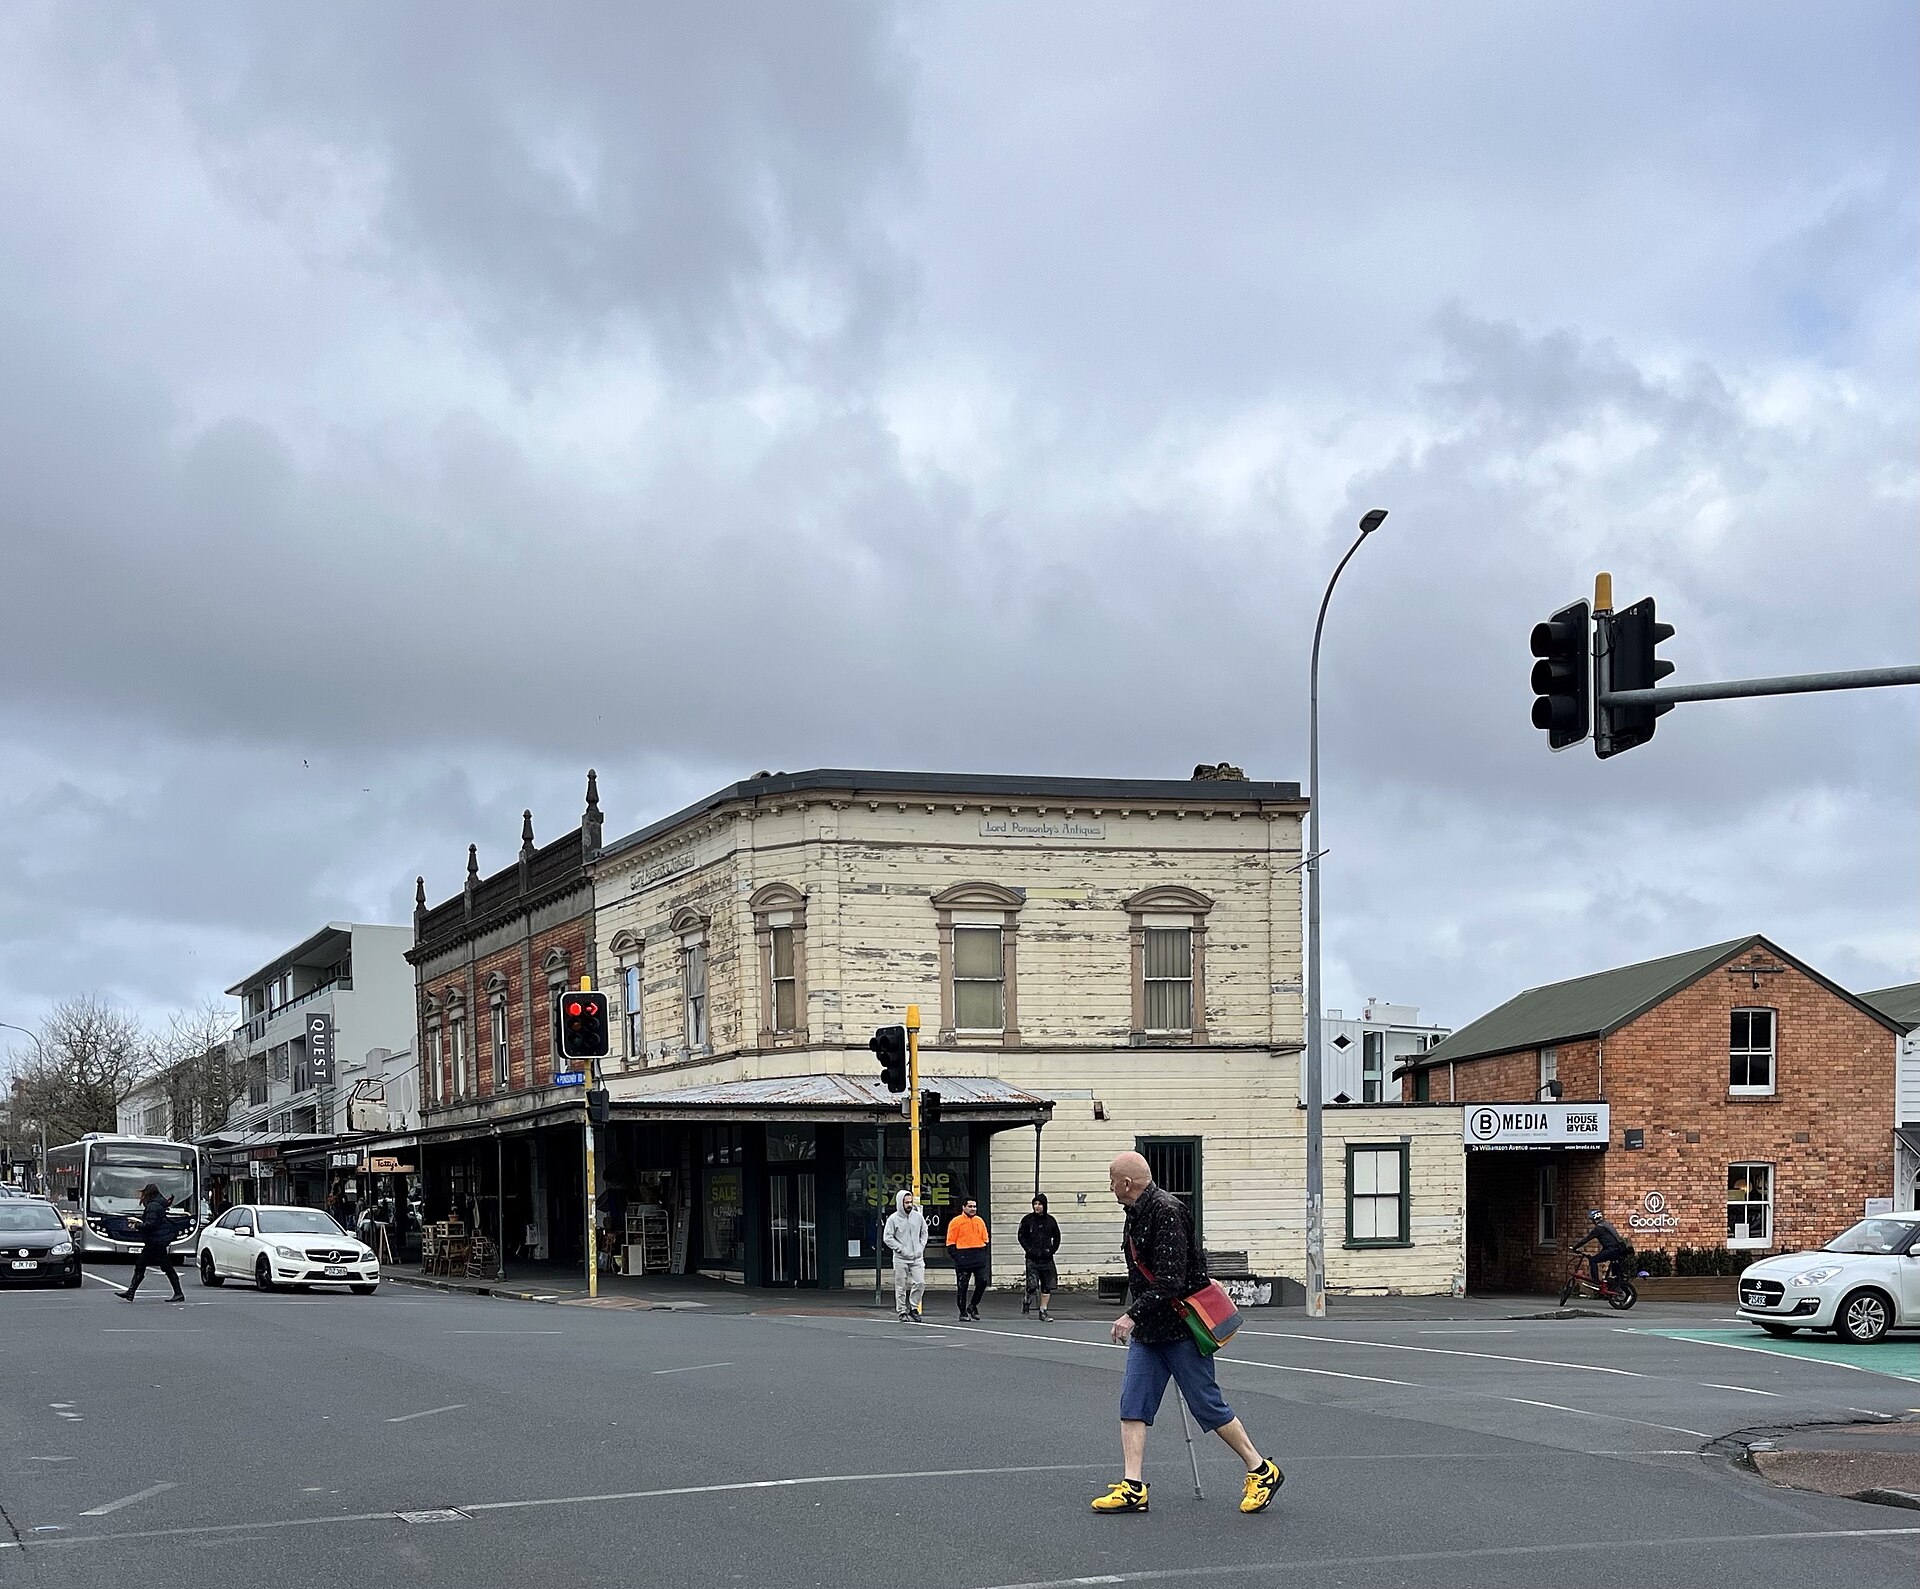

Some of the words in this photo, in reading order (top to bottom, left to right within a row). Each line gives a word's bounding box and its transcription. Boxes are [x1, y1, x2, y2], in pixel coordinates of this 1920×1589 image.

[985, 821, 1006, 832] Lord
[1012, 822, 1059, 835] Ponsonby's
[1062, 823, 1101, 836] Antiques
[310, 1018, 326, 1078] QUEST
[1502, 1113, 1548, 1130] MEDIA
[1566, 1115, 1598, 1124] HOUSE
[867, 1173, 950, 1184] CLOSNG
[711, 1186, 737, 1201] SALE
[1629, 1214, 1680, 1227] GoodFor
